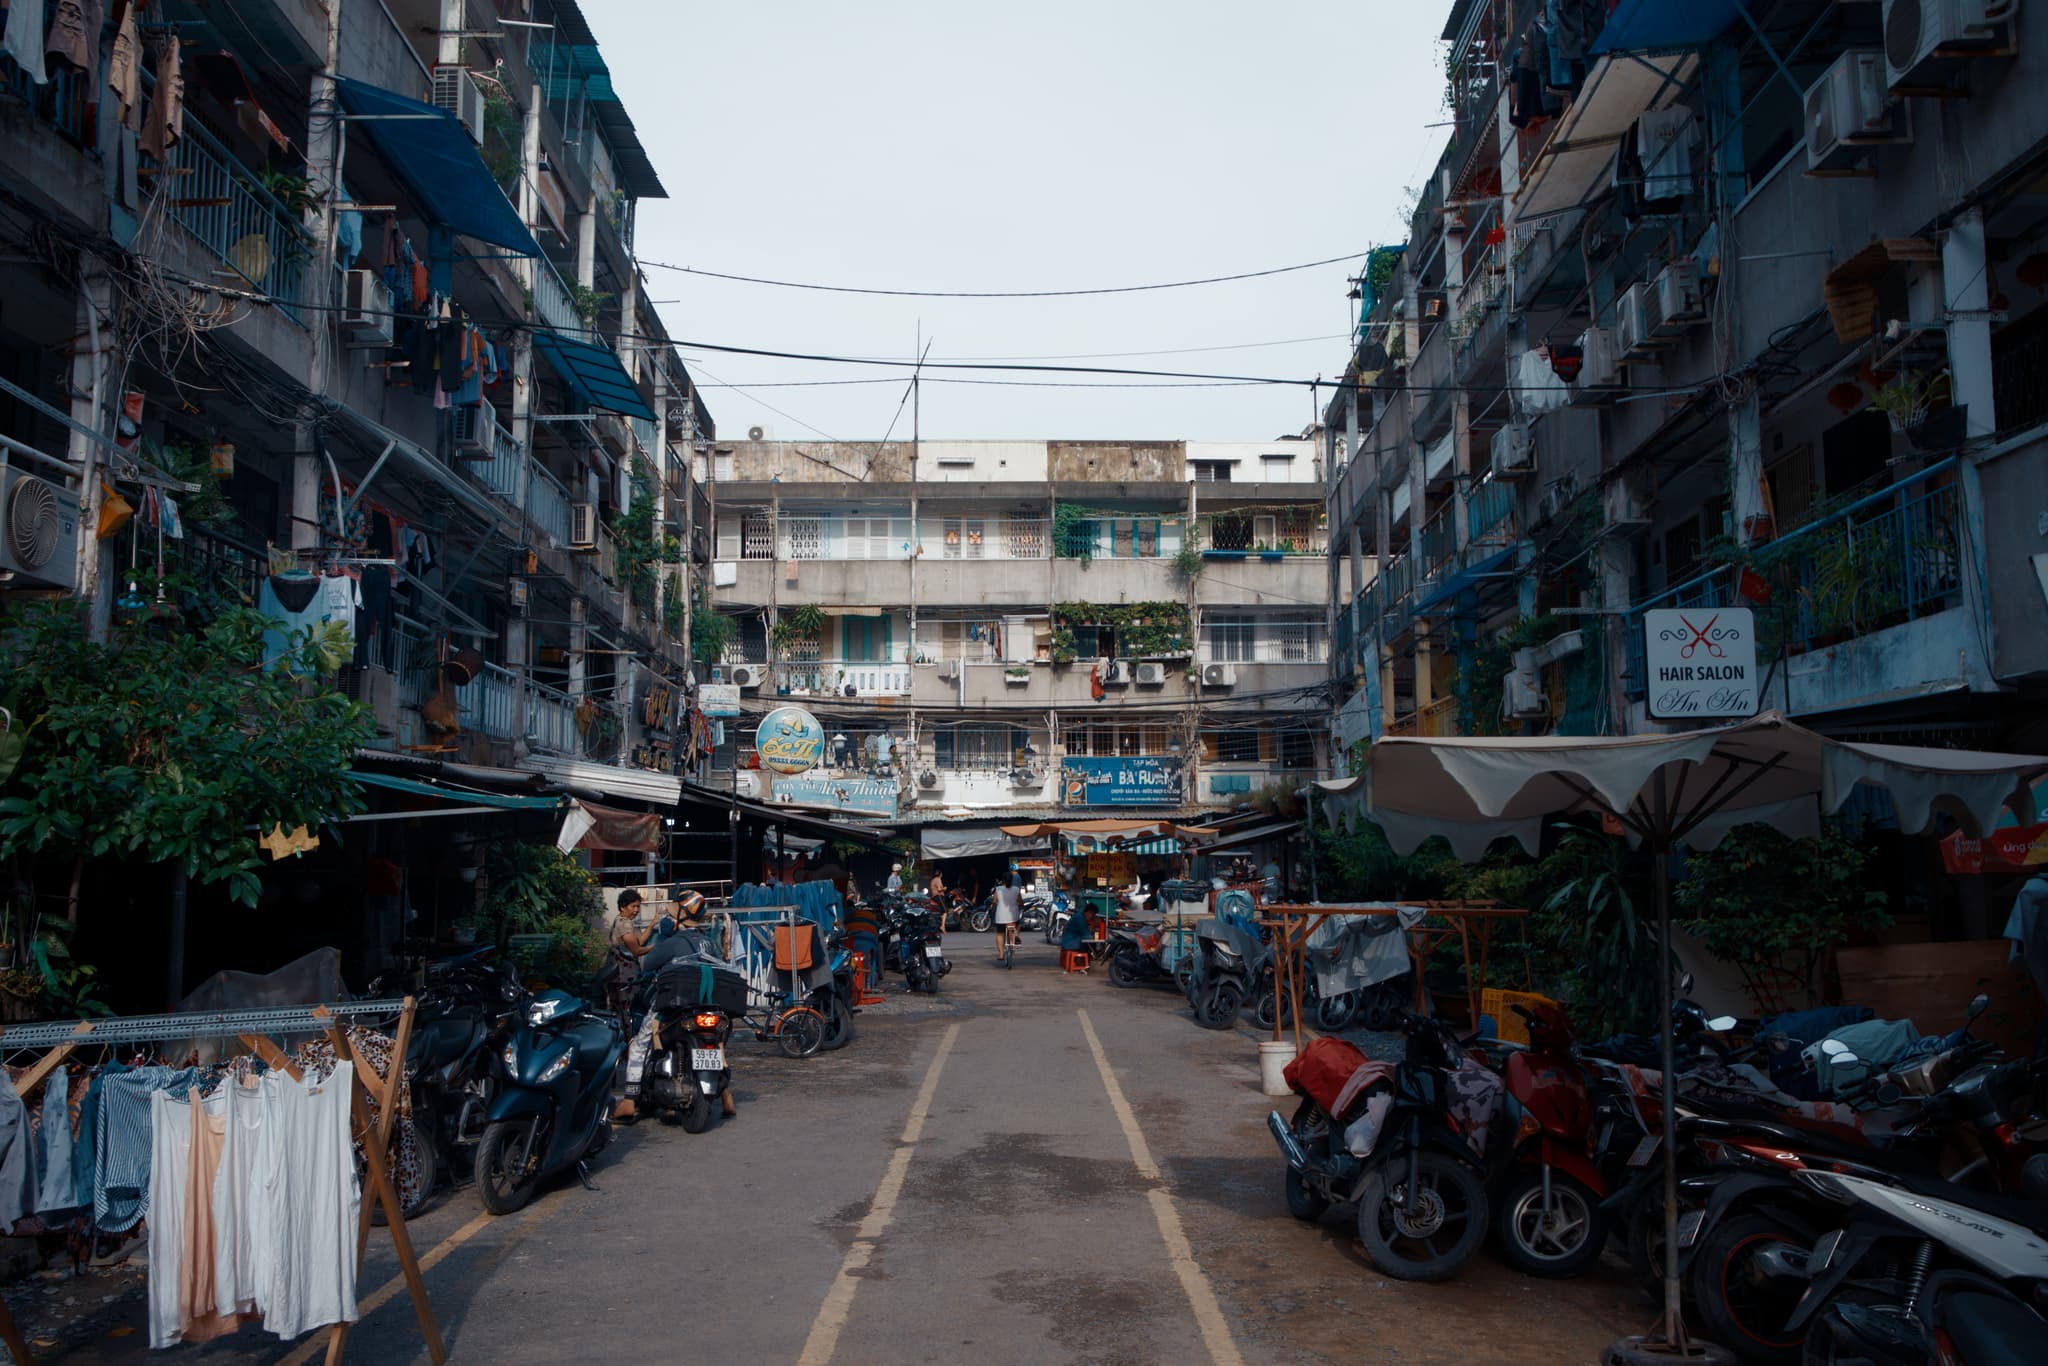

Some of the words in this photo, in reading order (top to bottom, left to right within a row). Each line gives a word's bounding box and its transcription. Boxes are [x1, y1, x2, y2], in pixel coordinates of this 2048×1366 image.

[1660, 667, 1694, 681] HAIR
[1697, 665, 1745, 681] SALON
[1657, 688, 1700, 713] An
[1707, 687, 1751, 712] An
